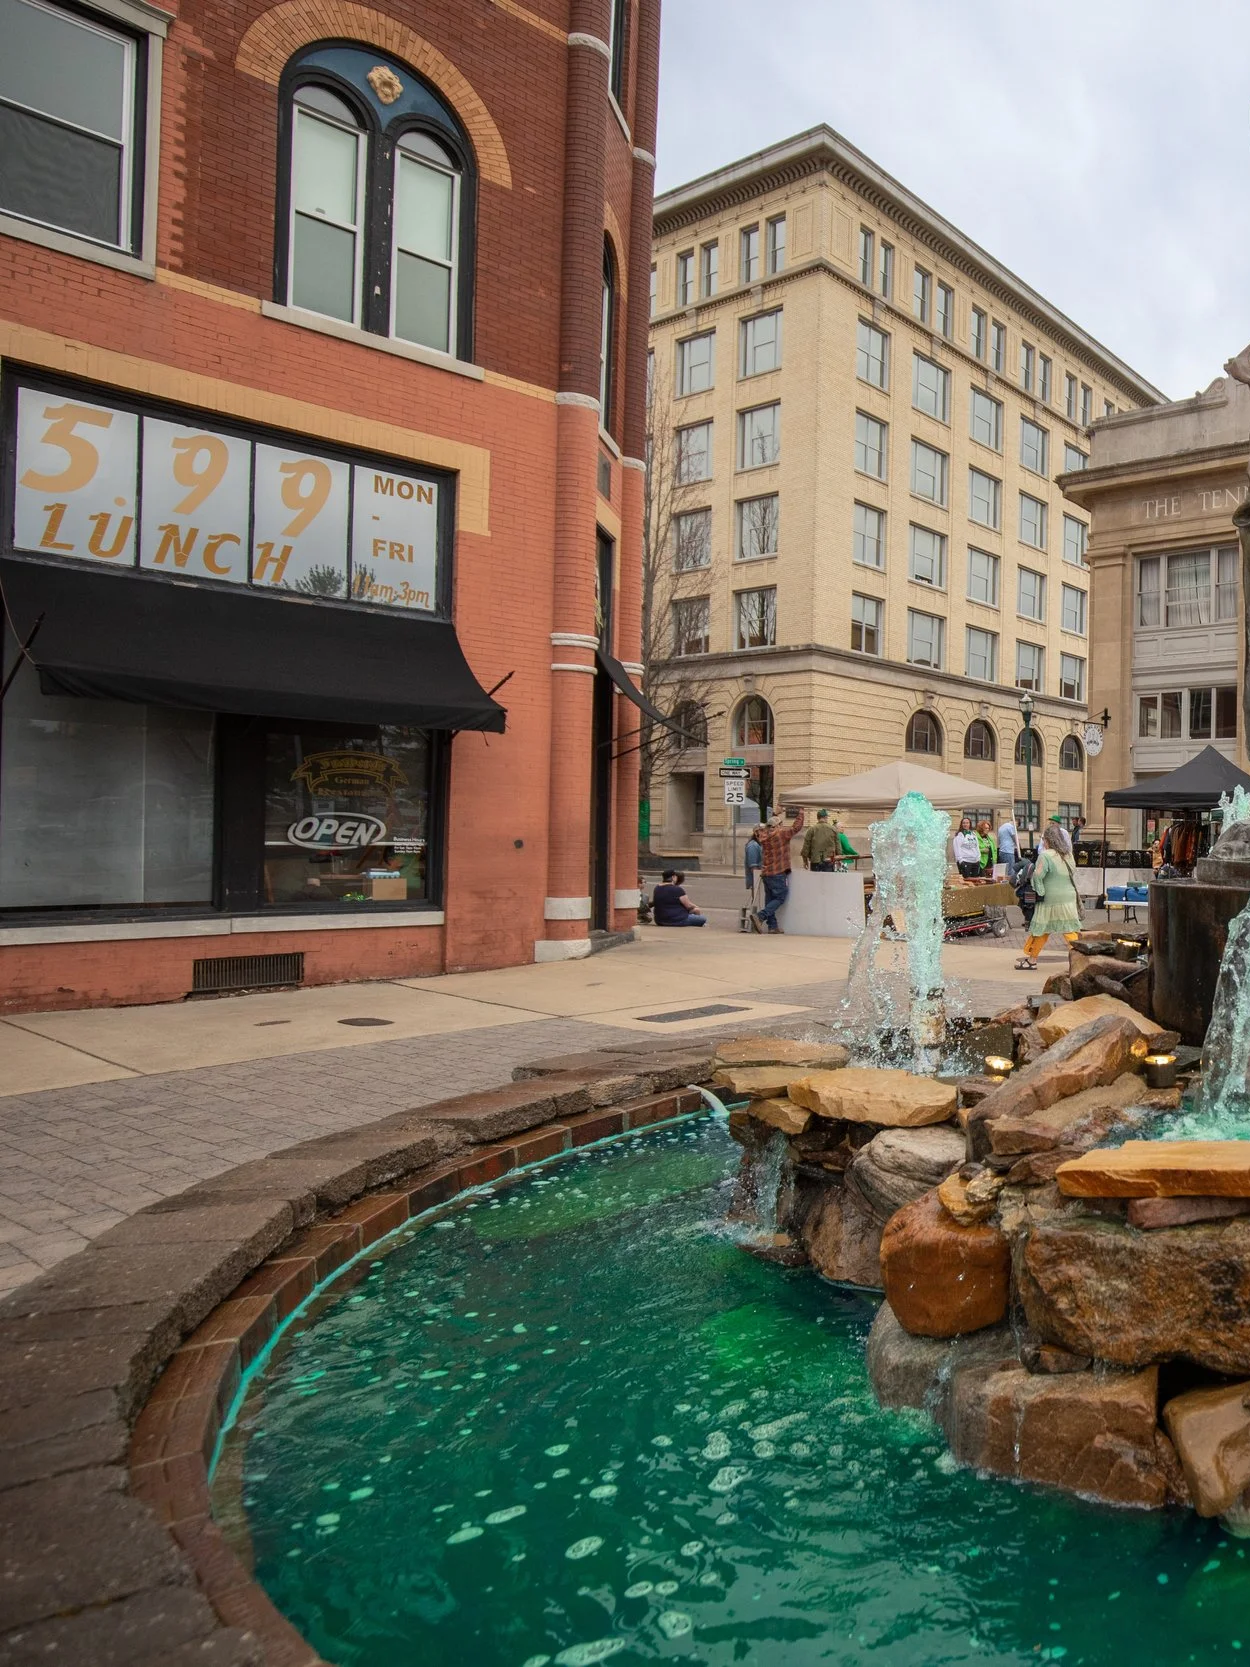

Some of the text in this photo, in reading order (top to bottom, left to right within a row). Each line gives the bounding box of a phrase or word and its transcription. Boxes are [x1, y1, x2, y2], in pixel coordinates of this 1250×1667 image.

[374, 474, 434, 505] MON
[1141, 496, 1181, 519] THE
[40, 502, 293, 583] LUNCH
[372, 538, 414, 563] FRI
[334, 776, 370, 786] German
[726, 792, 744, 802] 25
[295, 816, 377, 846] OPEN
